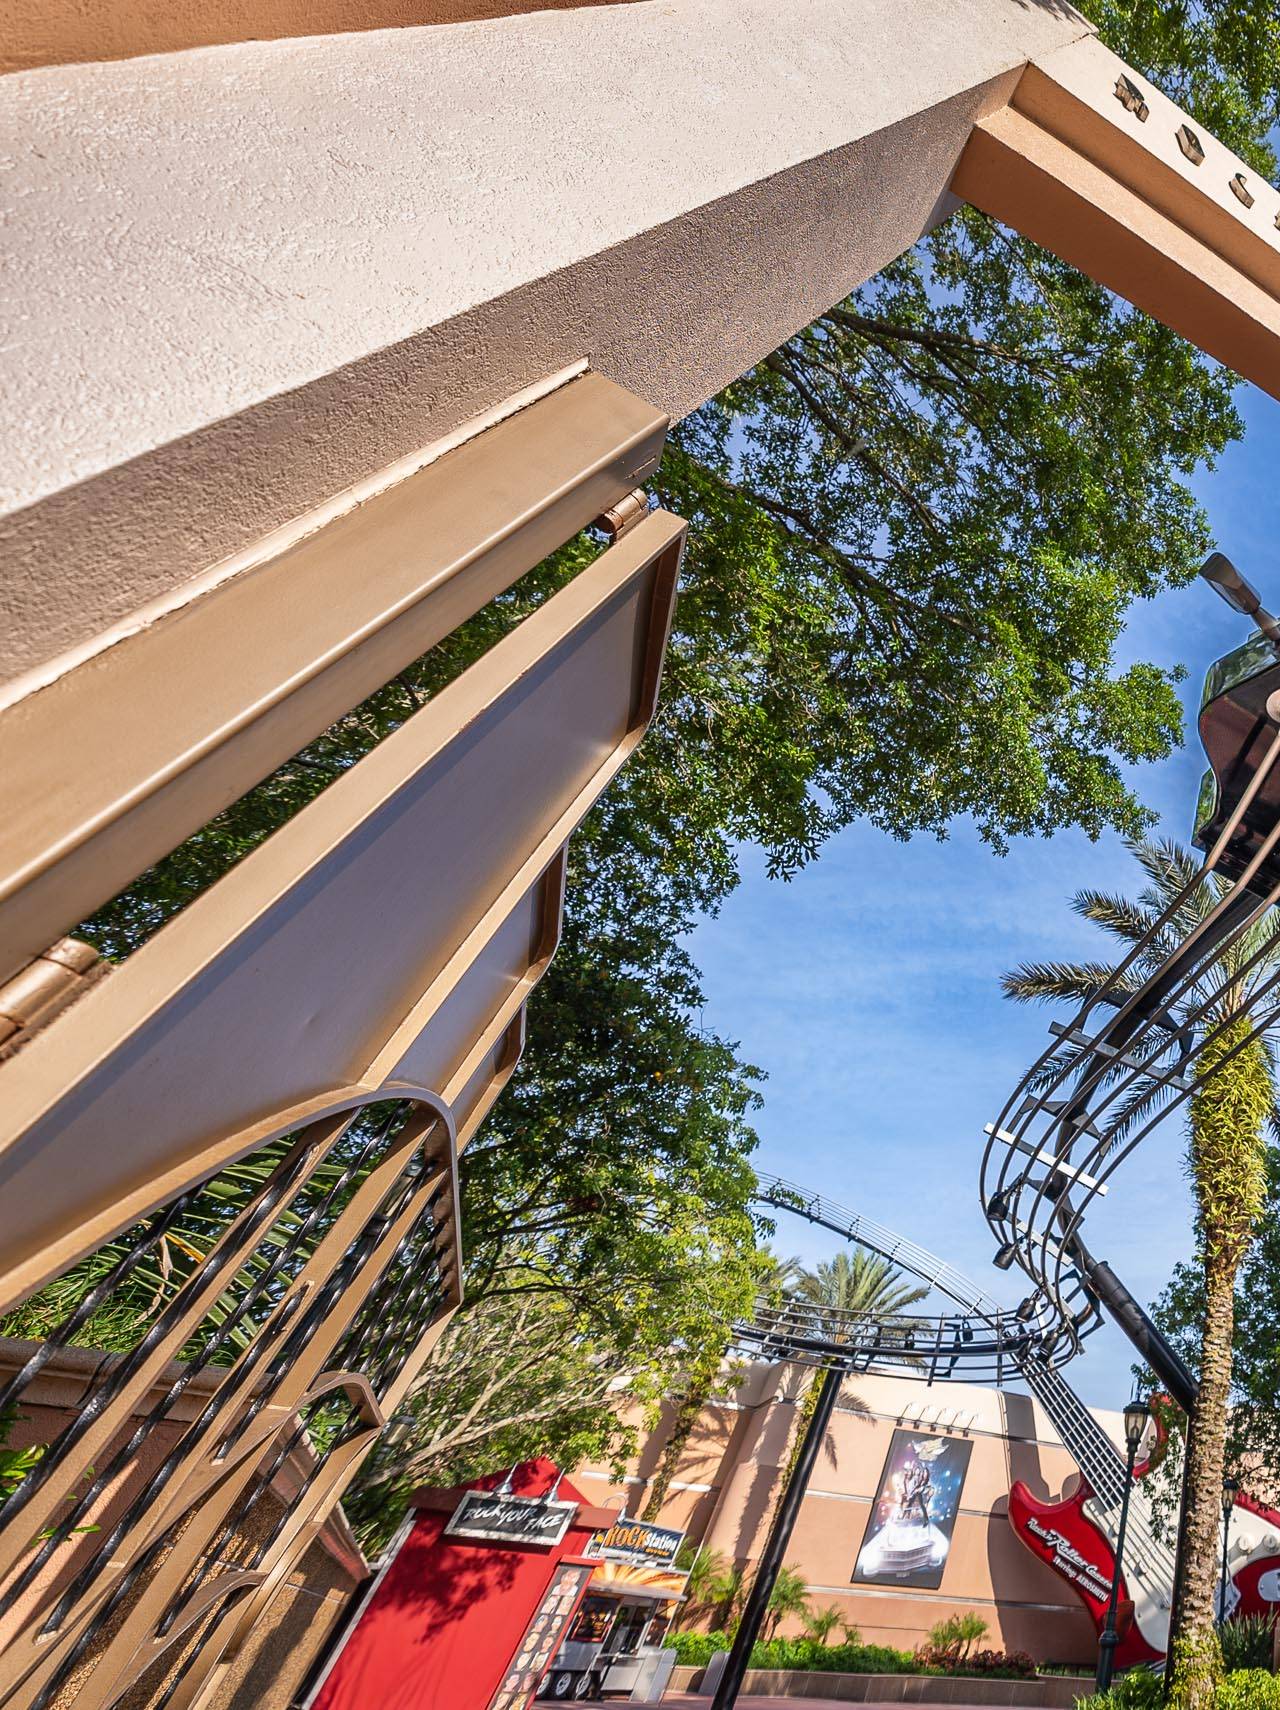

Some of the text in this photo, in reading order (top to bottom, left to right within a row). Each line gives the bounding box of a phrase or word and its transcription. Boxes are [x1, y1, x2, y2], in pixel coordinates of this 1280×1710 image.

[463, 1503, 537, 1527] ROCK YOUR
[523, 1513, 564, 1531] FACE
[604, 1525, 648, 1549] ROCK
[644, 1530, 678, 1552] Station
